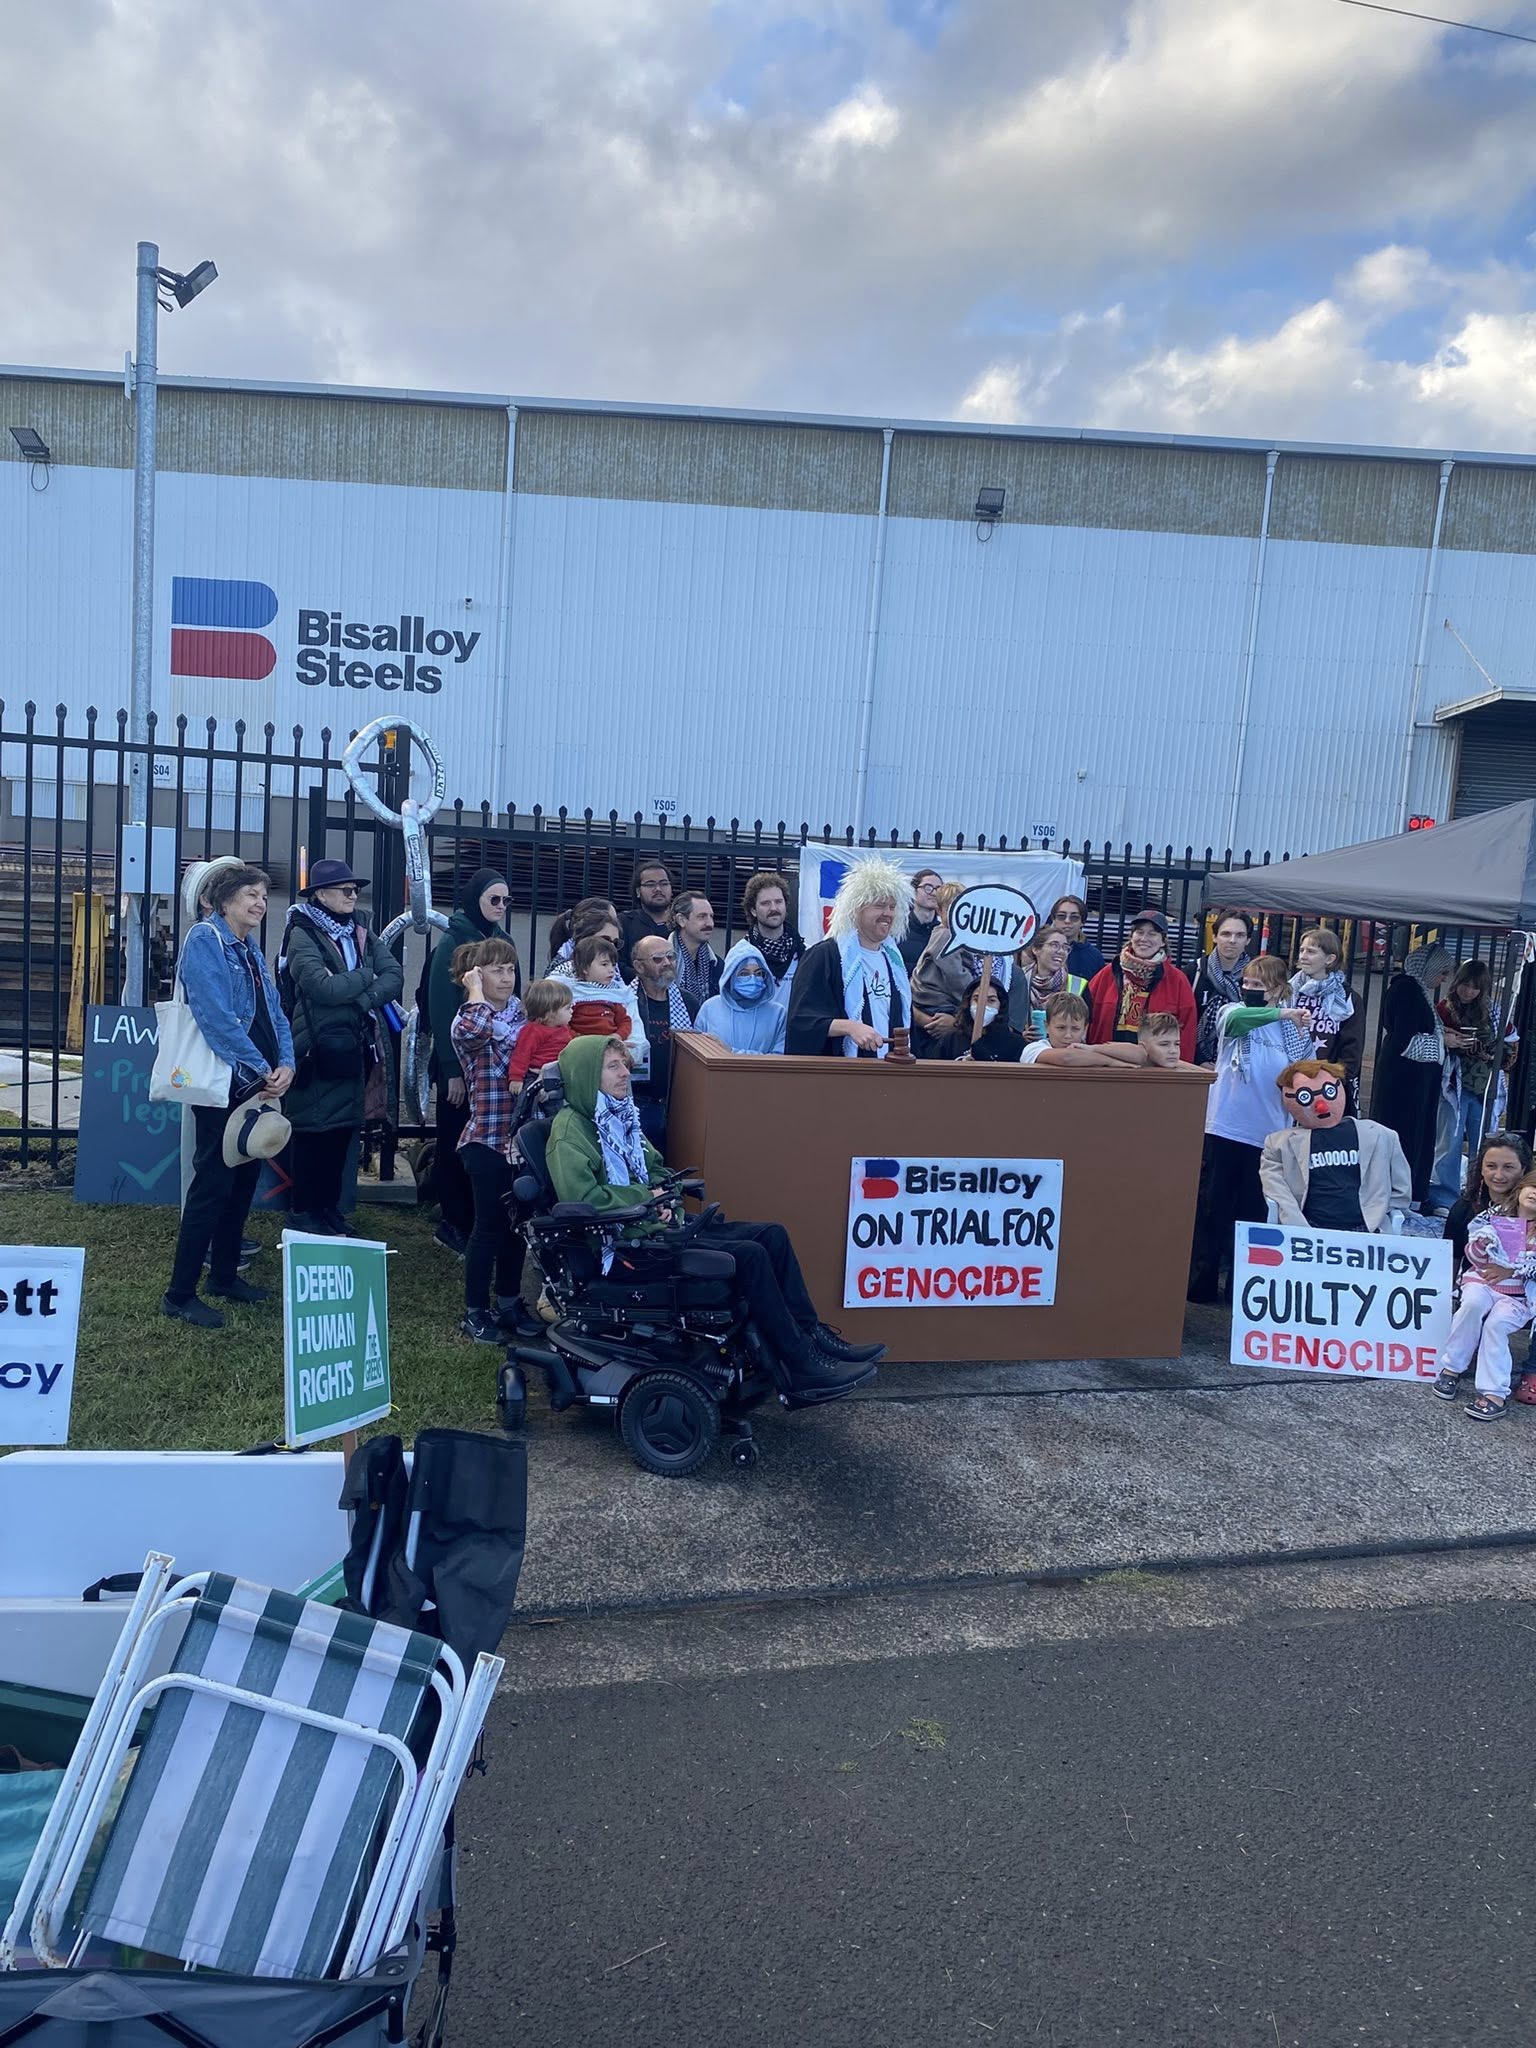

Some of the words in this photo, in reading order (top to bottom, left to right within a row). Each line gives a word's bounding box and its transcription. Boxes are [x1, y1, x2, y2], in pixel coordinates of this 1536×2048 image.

[298, 609, 481, 663] Bisalloy
[296, 648, 443, 694] Steels
[153, 764, 170, 775] S04
[653, 799, 676, 811] YS05
[1032, 824, 1056, 837] YS06
[955, 901, 1035, 945] GUILTY!
[905, 1165, 1042, 1199] Bisalloy
[852, 1211, 904, 1248] ON
[910, 1207, 1000, 1247] TRIAL
[1002, 1207, 1055, 1250] FOR
[1290, 1237, 1431, 1280] Bisalloy
[295, 1265, 354, 1303] DEFEND
[857, 1265, 1043, 1302] GENOCIDE
[1241, 1275, 1378, 1327] GUILTY
[1386, 1286, 1438, 1330] OF
[297, 1312, 356, 1354] HUMAN
[1244, 1330, 1438, 1378] GENOCIDE
[299, 1360, 355, 1407] RIGHTS
